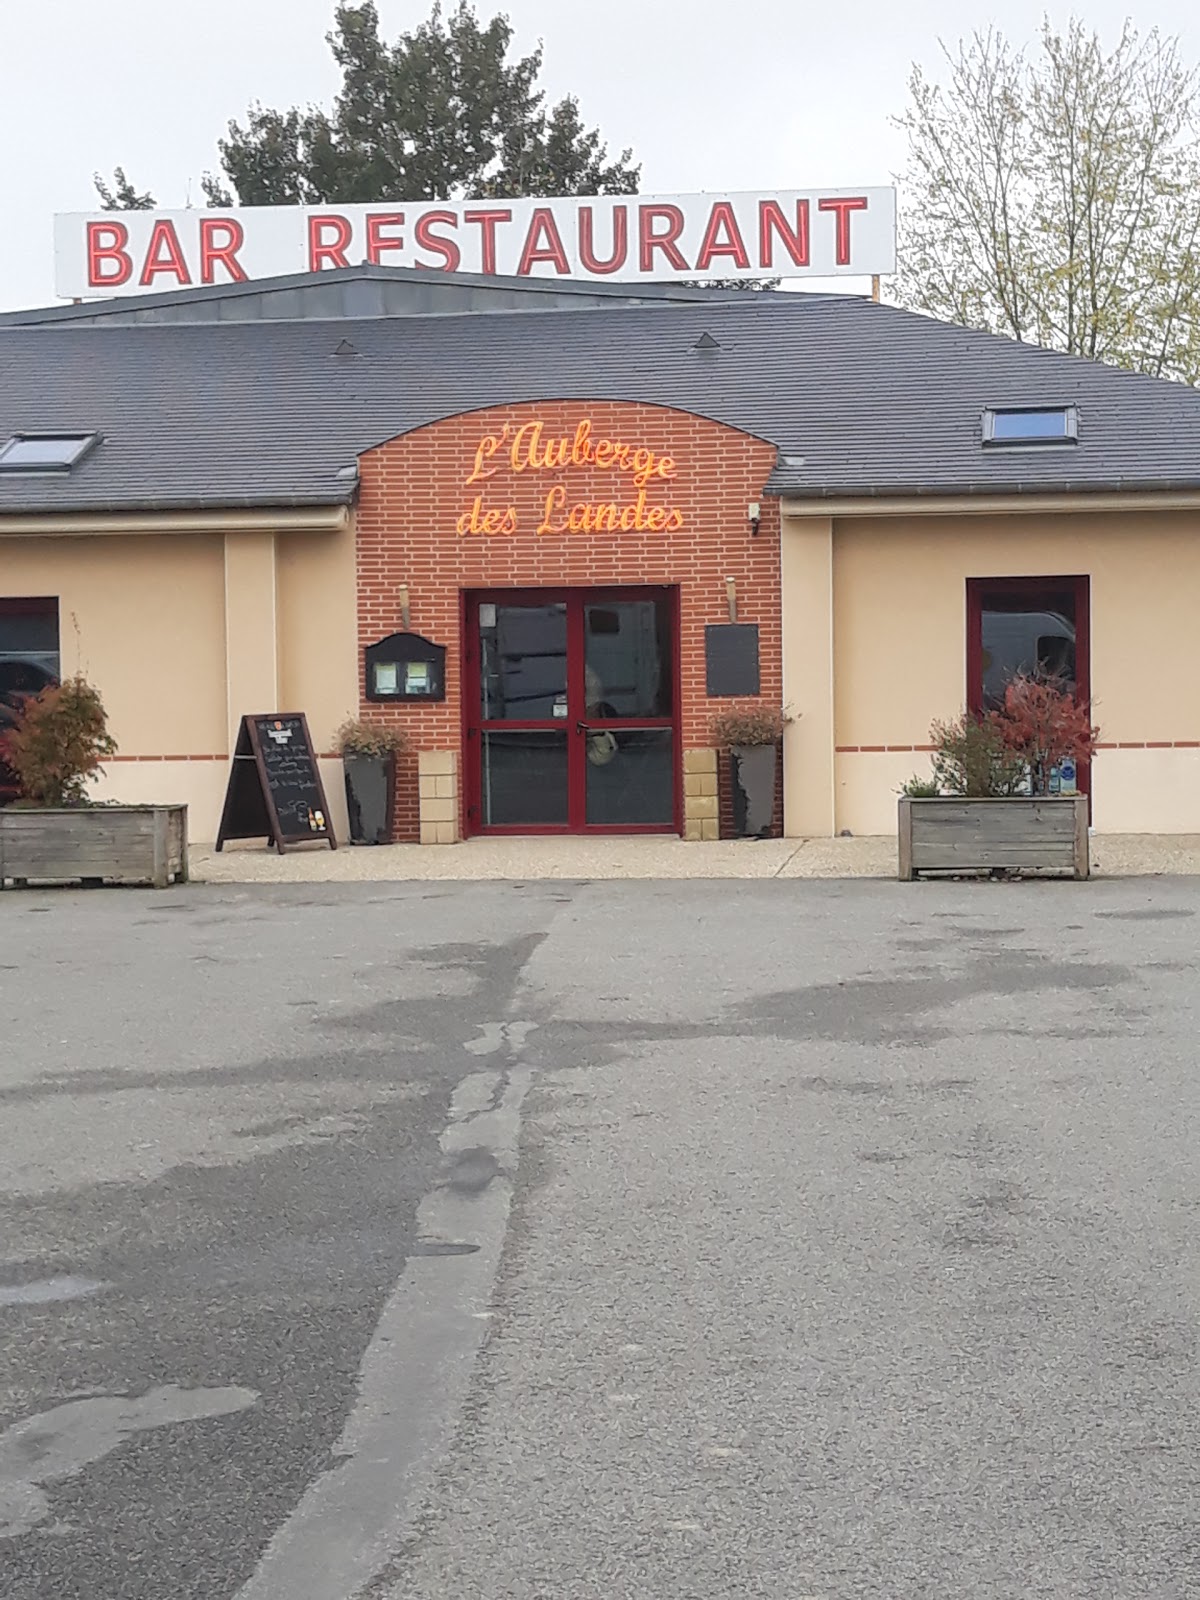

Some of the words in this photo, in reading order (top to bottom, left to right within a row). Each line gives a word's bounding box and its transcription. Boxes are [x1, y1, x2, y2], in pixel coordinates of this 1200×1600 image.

[87, 217, 249, 288] BAR
[307, 196, 868, 277] RESTAURANT
[465, 419, 678, 487] L'Auberge
[456, 495, 518, 536] des
[536, 485, 684, 535] Landes
